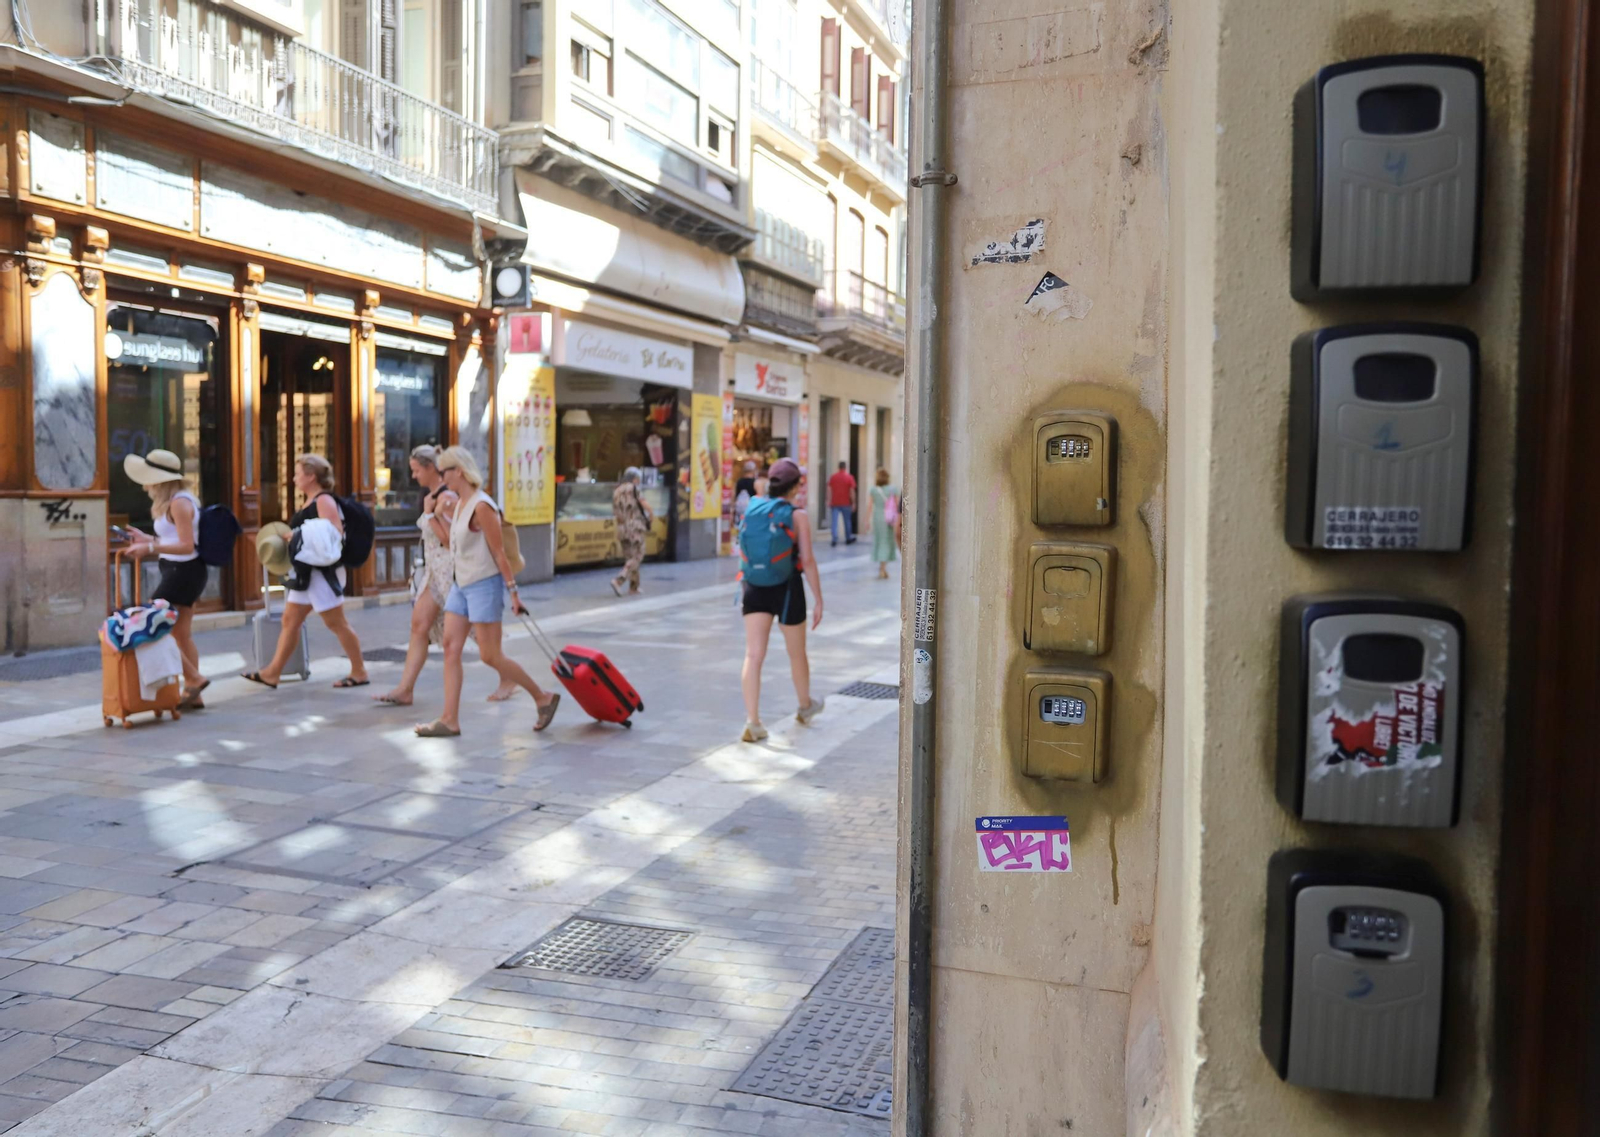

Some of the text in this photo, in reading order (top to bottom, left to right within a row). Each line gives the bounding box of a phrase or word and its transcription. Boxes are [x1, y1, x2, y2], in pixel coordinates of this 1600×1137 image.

[124, 340, 181, 363] sunglass
[576, 331, 631, 363] Gelateria
[1326, 510, 1419, 522] CERRAJERO
[1326, 536, 1418, 548] 619 32 44 32
[914, 589, 922, 639] CERRAJERO
[926, 590, 936, 640] 619 32 44 32
[1399, 693, 1418, 712] DE
